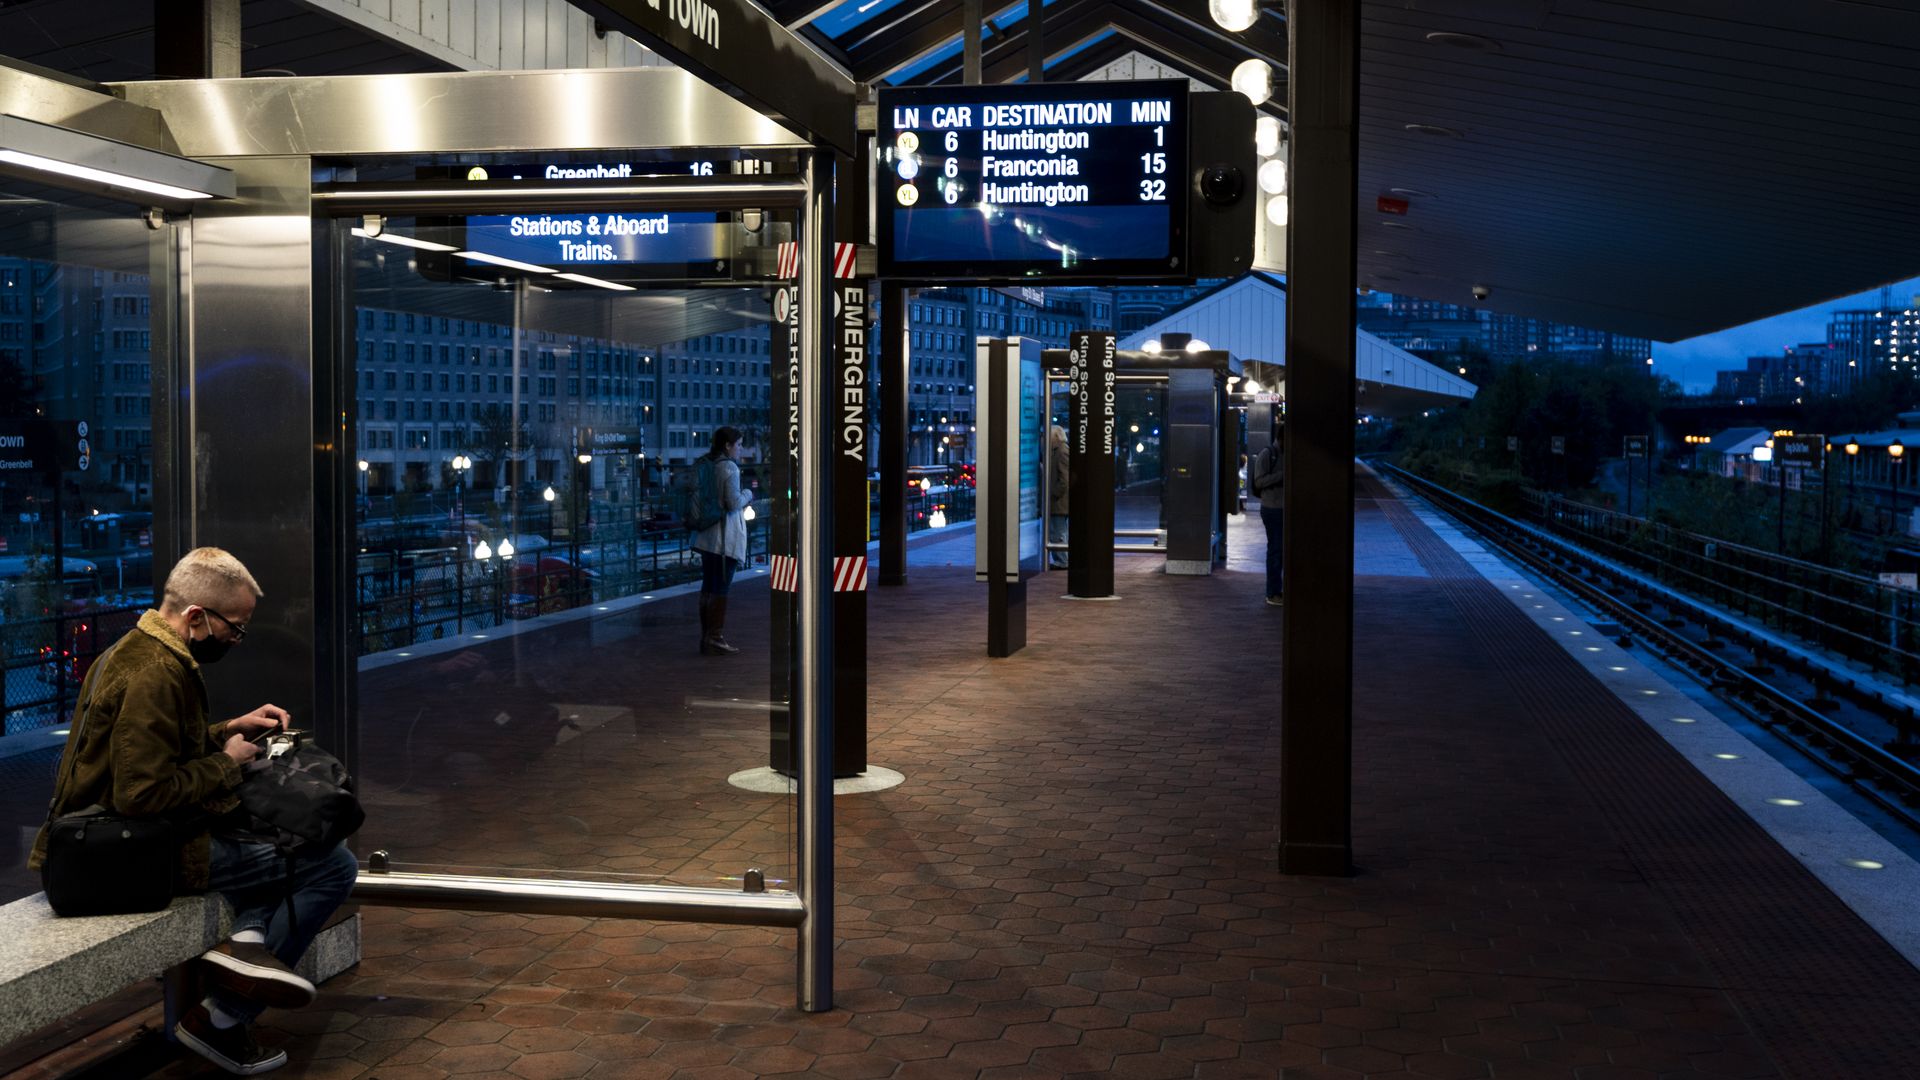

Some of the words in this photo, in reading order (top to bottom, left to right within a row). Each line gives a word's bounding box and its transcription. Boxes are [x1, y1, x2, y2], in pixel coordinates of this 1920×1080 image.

[893, 107, 920, 129] LN
[931, 106, 972, 128] CAR
[982, 102, 1112, 127] DESTINATION
[1131, 101, 1171, 123] MIN
[944, 131, 959, 151] 6
[982, 129, 1089, 153] Huntington
[1153, 126, 1164, 146] 1
[545, 164, 632, 179] Greenbelt
[689, 162, 714, 176] 16
[944, 157, 959, 178] 6
[982, 155, 1079, 177] Franconia
[1140, 153, 1166, 174] 15
[944, 184, 959, 204] 6
[982, 181, 1089, 207] Huntington
[1139, 180, 1166, 201] 32
[510, 216, 582, 236] Stations
[586, 215, 601, 235] &
[603, 214, 669, 235] Aboard
[559, 240, 618, 261] Trains.
[1079, 335, 1089, 367] King
[1103, 335, 1116, 368] King
[790, 286, 799, 465] EMERGENCY
[844, 287, 864, 461] EMERGENCY
[1080, 371, 1089, 415] St-Old
[1104, 371, 1115, 416] St-Old
[0, 436, 24, 447] own
[1079, 417, 1088, 454] Town
[1104, 417, 1115, 454] Town
